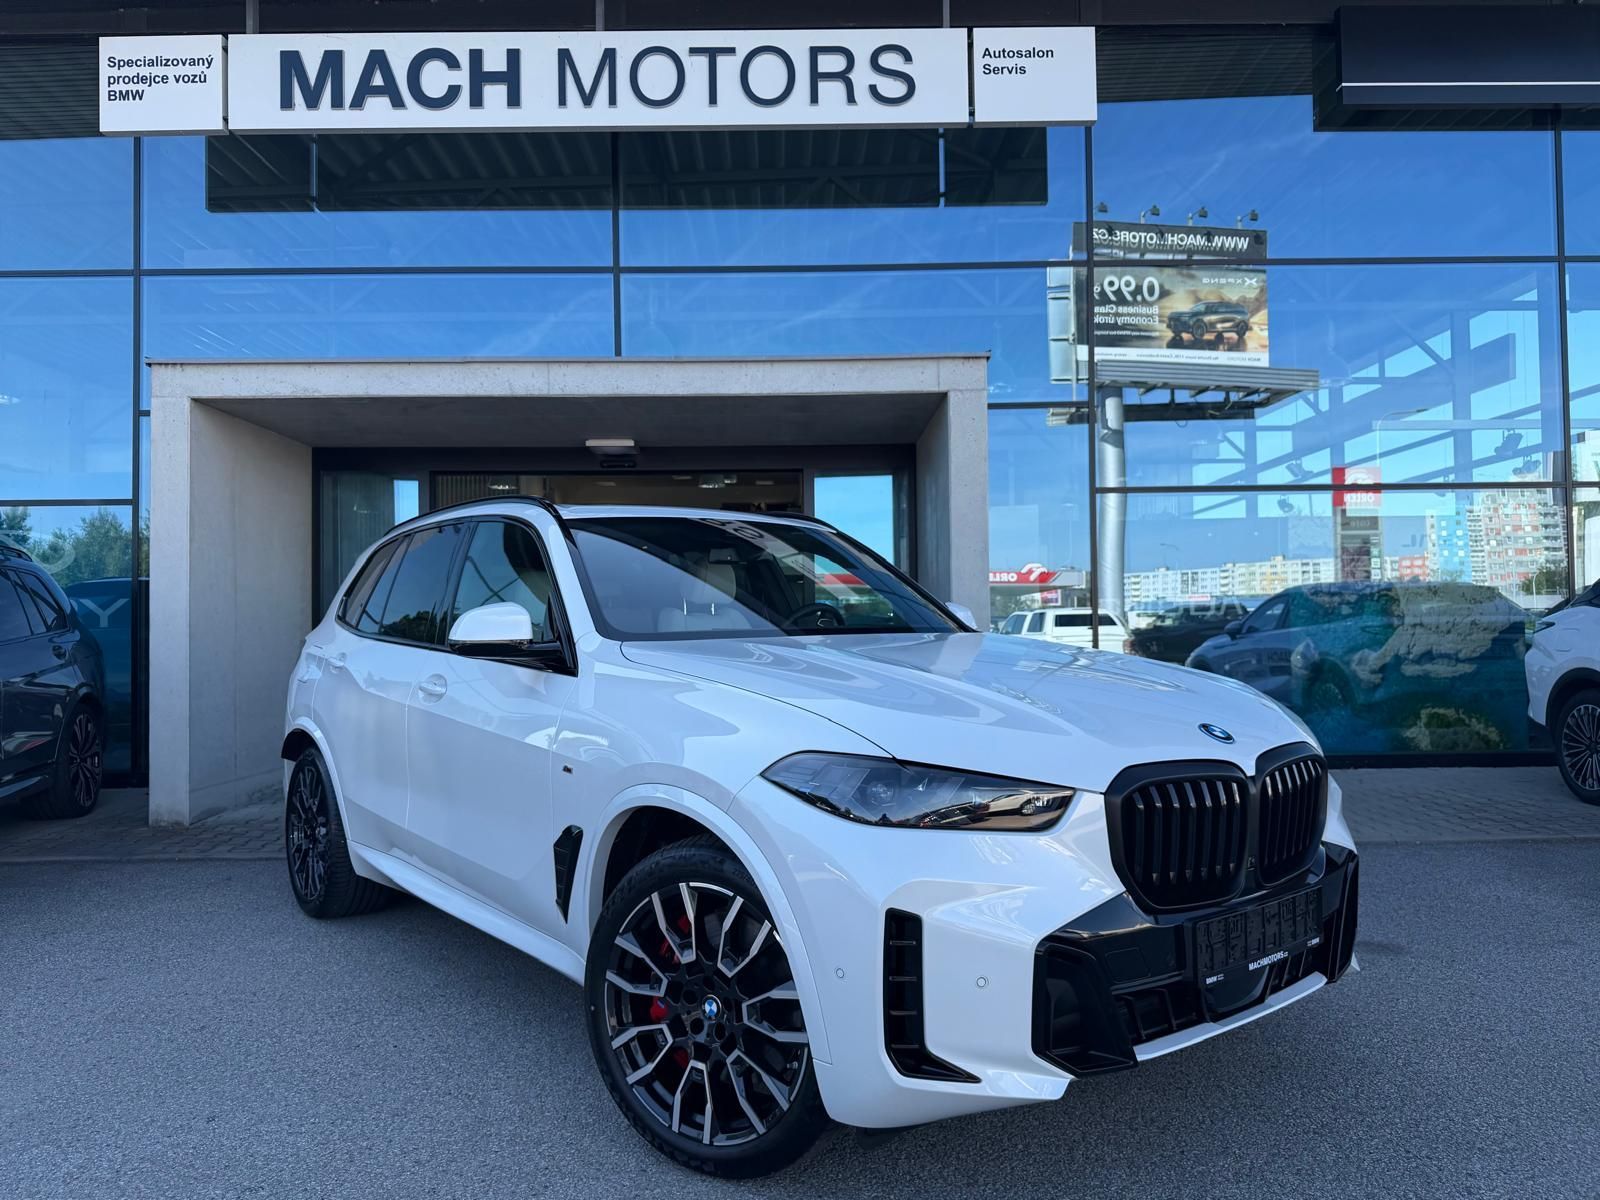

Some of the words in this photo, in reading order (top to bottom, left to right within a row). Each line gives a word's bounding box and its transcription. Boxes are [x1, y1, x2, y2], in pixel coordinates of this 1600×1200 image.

[981, 46, 1054, 60] Autosalon
[107, 54, 214, 71] Specializovaný
[982, 63, 1027, 76] Servis
[107, 72, 169, 88] prodejce
[173, 71, 207, 84] vozů
[279, 48, 522, 111] MACH
[557, 44, 917, 110] MOTORS
[107, 89, 145, 102] BMW
